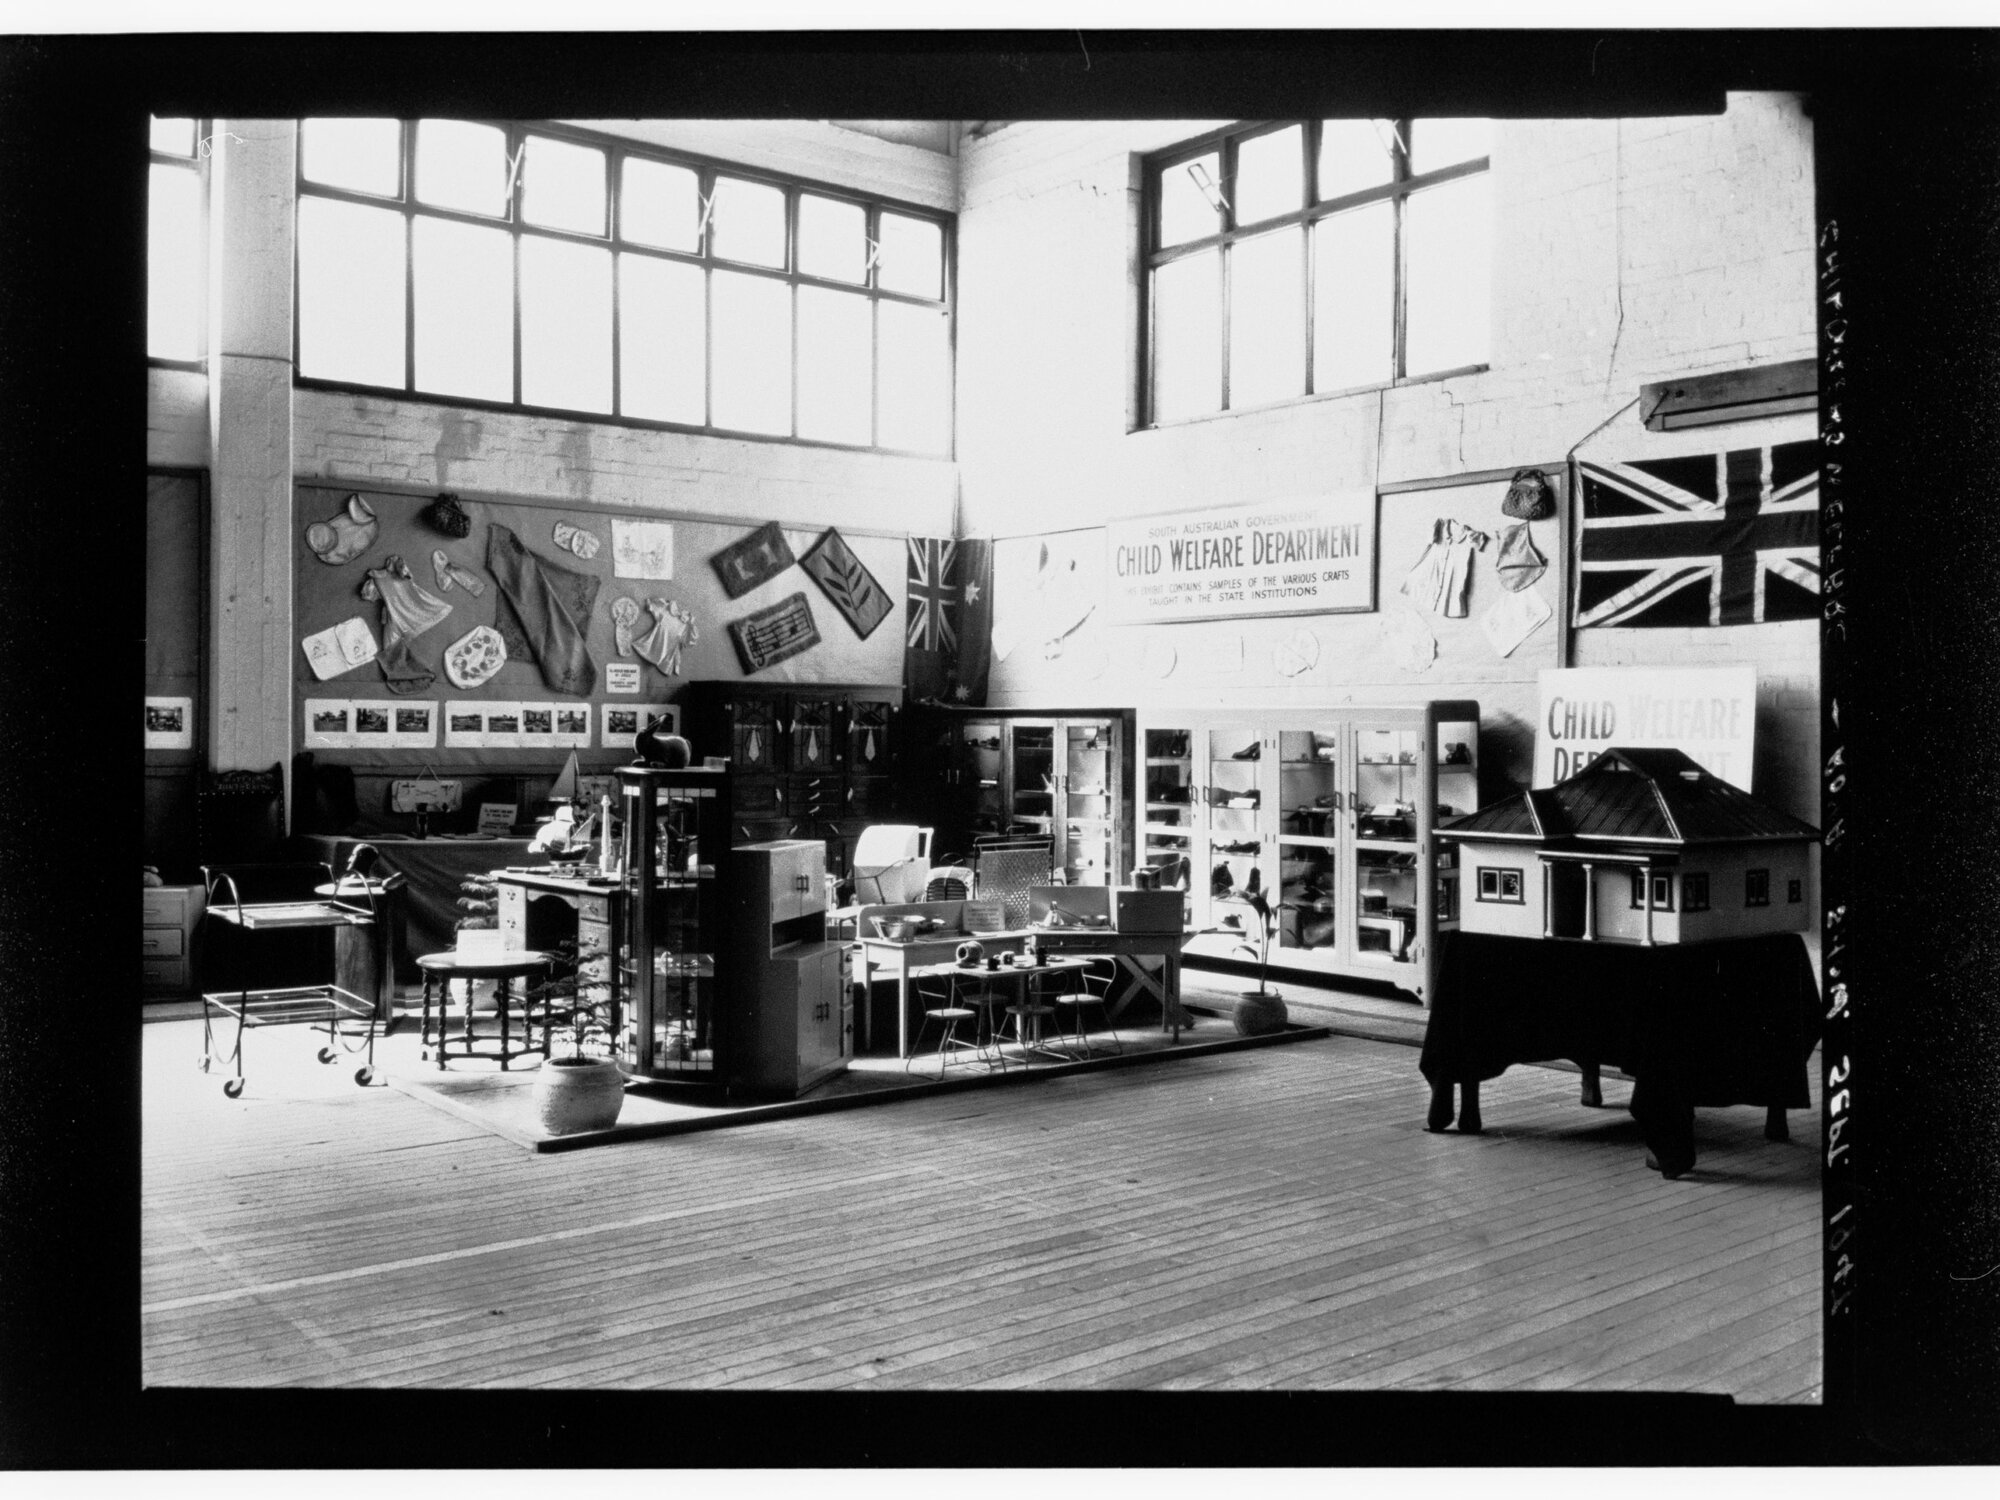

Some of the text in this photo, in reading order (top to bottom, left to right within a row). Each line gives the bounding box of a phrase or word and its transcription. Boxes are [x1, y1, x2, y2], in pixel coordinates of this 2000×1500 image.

[1148, 510, 1319, 538] SOUTH AUSTRALIAN GOVERNMENT
[1116, 523, 1363, 577] CHILD WELFARE DEPARTMENT
[1169, 581, 1202, 593] CONTAINS
[1208, 578, 1243, 590] SAMPLES
[1248, 577, 1258, 588] OF
[1263, 576, 1277, 586] THE
[1282, 572, 1318, 585] VARIOUS
[1322, 569, 1350, 582] CRAFTS
[1148, 586, 1318, 607] TAUGHT IN THE STATE INSTITUTIONS
[1547, 695, 1742, 741] CHILD WELFARE
